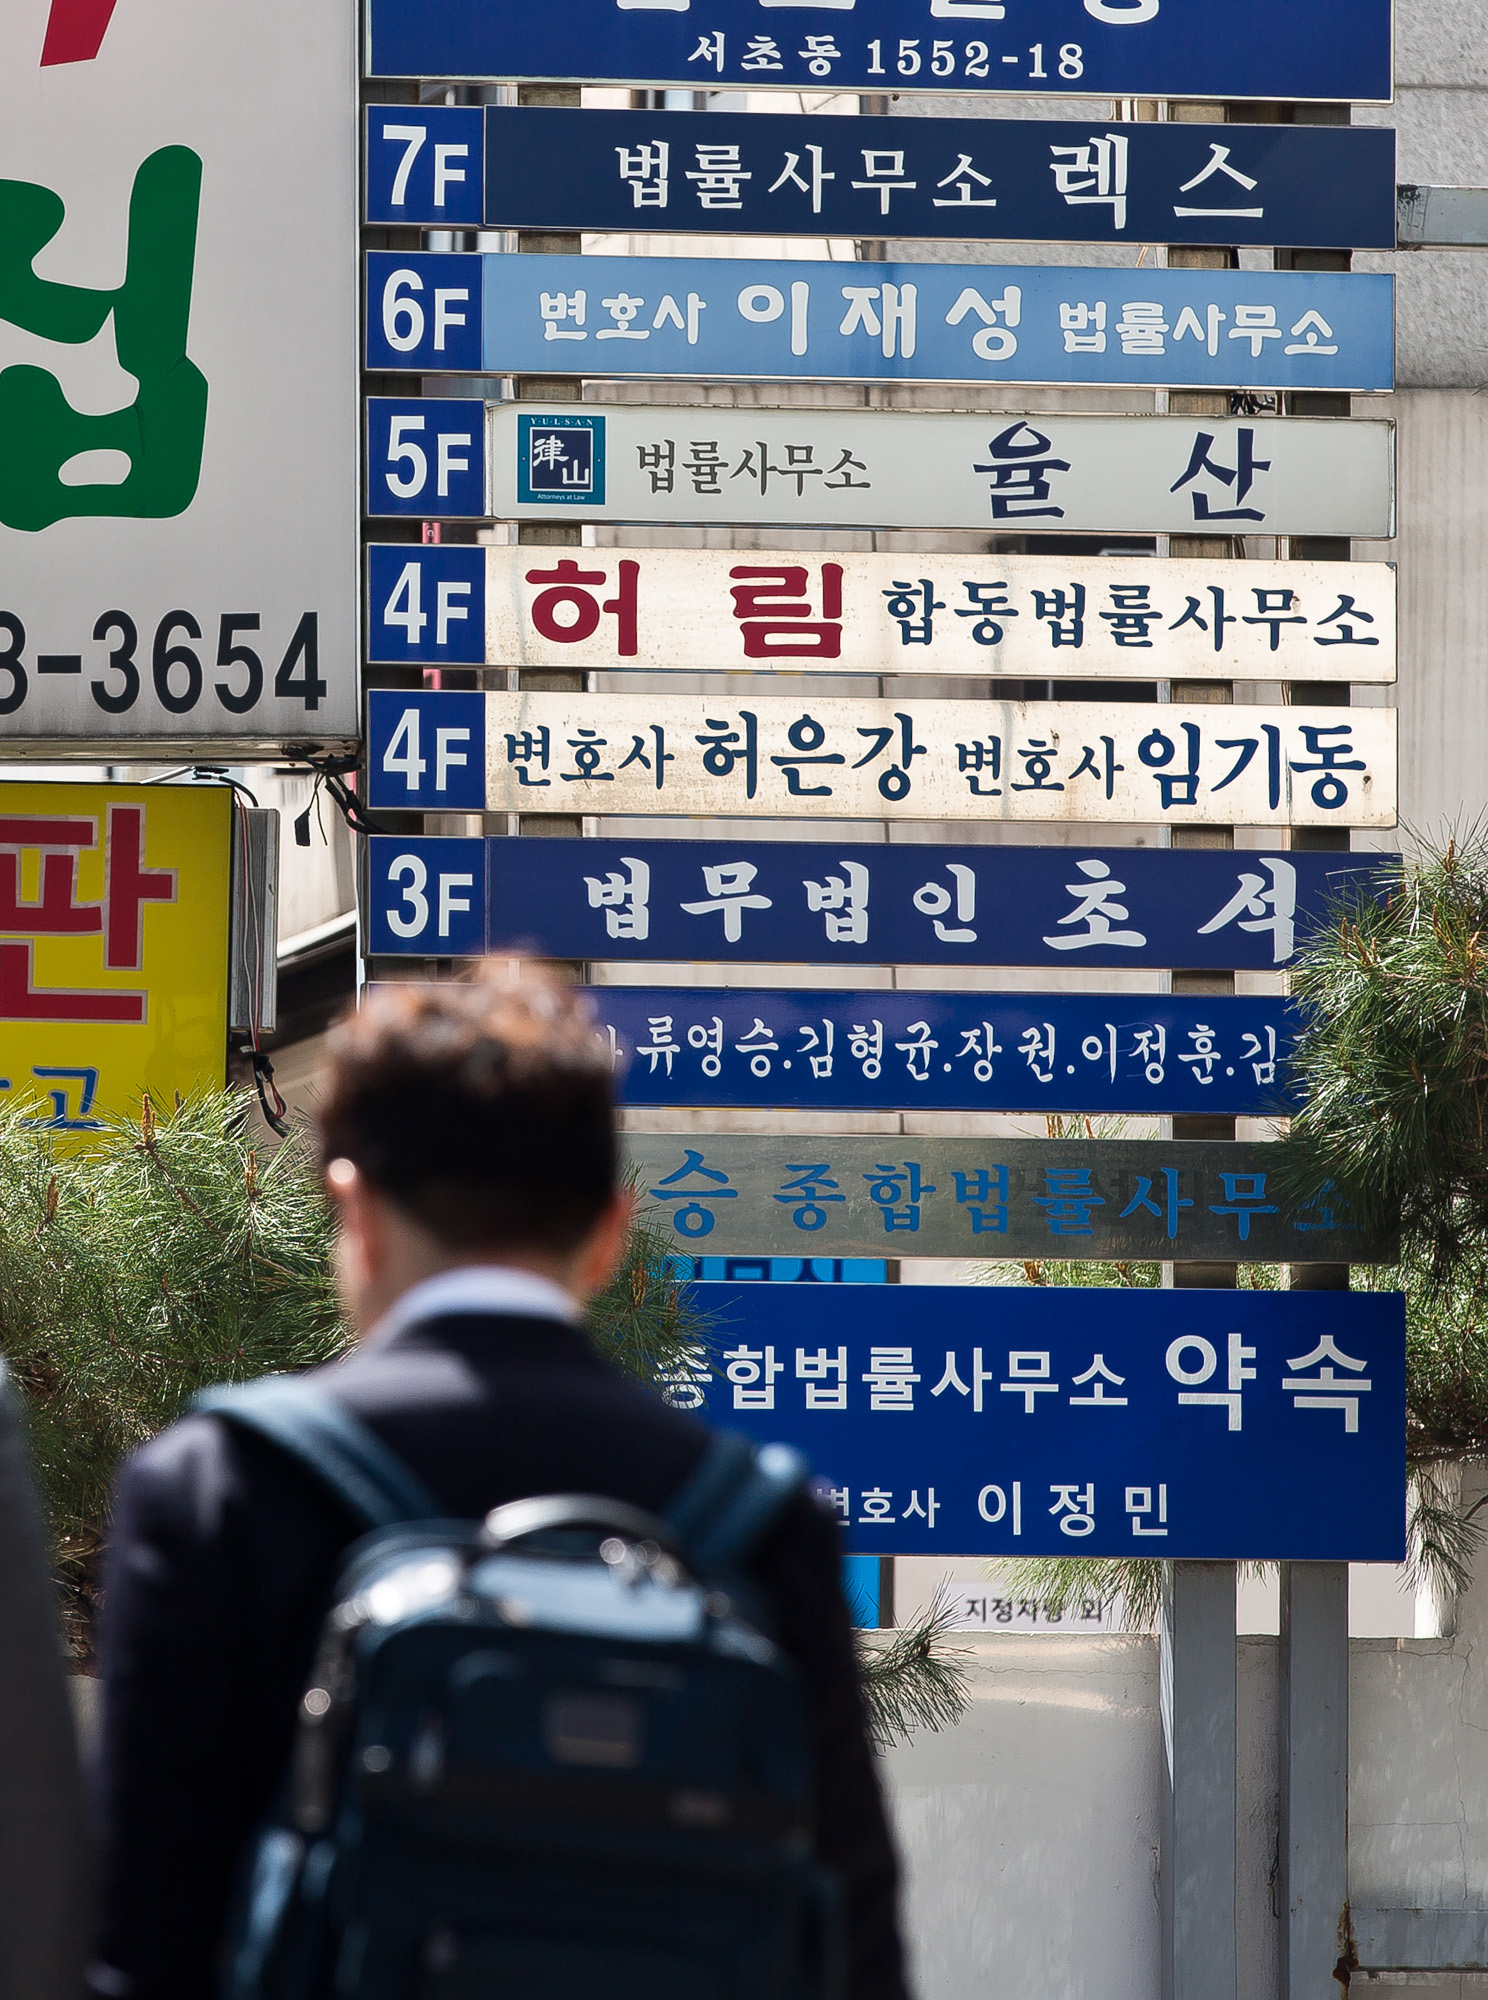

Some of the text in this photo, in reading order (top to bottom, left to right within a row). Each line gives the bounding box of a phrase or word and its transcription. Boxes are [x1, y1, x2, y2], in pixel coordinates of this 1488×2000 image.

[687, 31, 1086, 79] 서초동 1552-18
[382, 124, 469, 207] 7F
[614, 139, 997, 216] 법률사무소
[382, 268, 469, 352] 6F
[538, 281, 1339, 361] 변호사 이재성 법률사무소
[384, 415, 472, 499] 5F
[635, 439, 872, 497] 법률사무소
[383, 561, 472, 645] 4F
[881, 578, 1380, 652] 합동법률사무소
[382, 708, 471, 791] 4F
[503, 710, 1368, 810] 변호사 허은강 변호사 임기동
[386, 854, 474, 938] 3F
[583, 857, 978, 943] 법무법인
[1165, 1333, 1373, 1433] 약속
[977, 1481, 1169, 1538] 이정민
